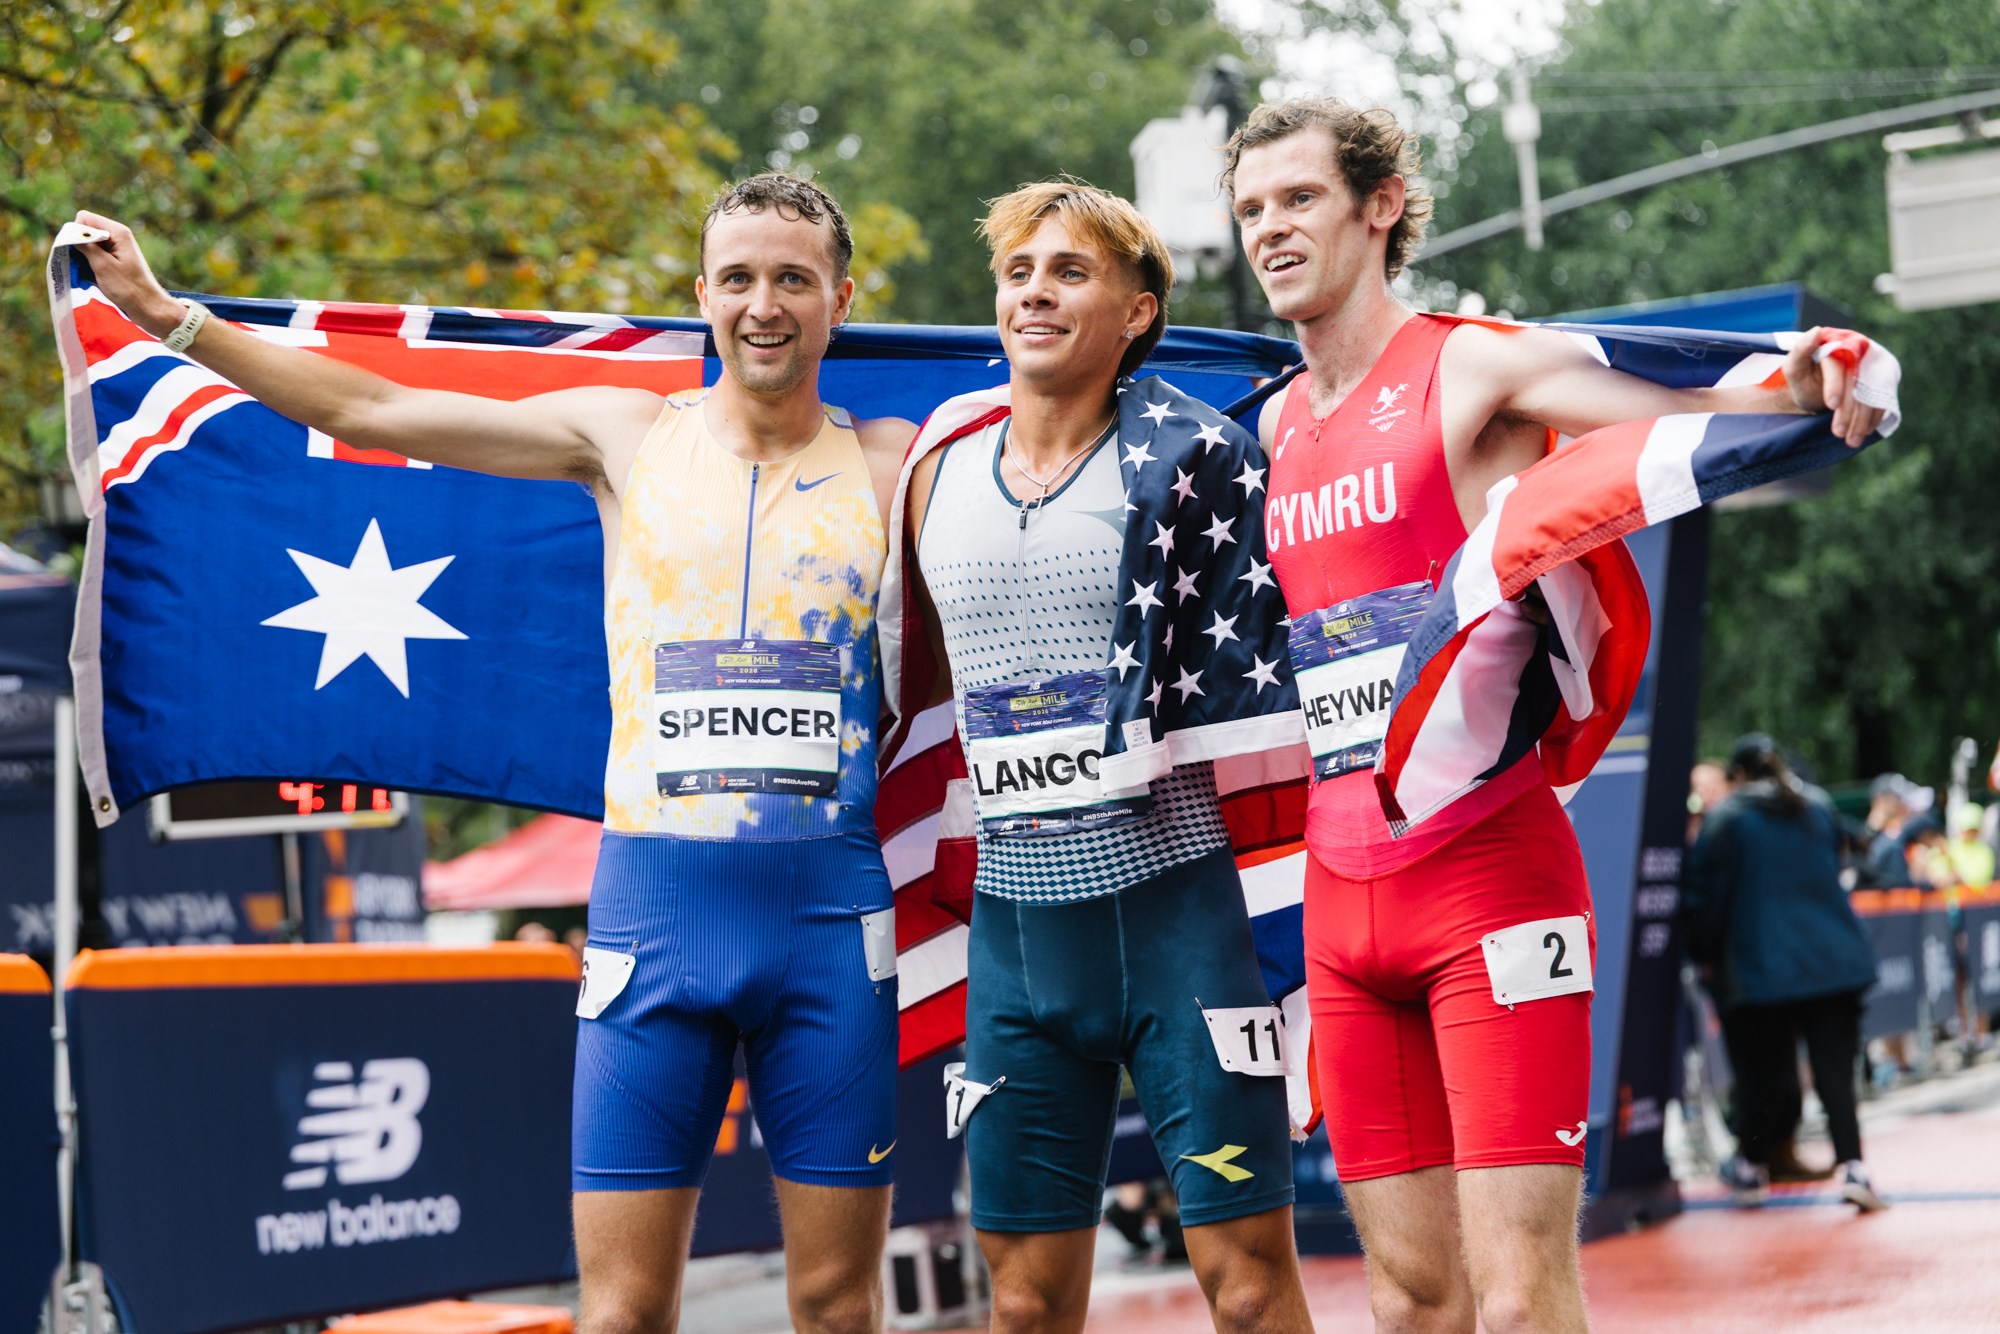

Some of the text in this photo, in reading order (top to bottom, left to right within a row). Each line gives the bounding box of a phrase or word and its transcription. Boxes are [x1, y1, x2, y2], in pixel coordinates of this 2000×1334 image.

[1266, 461, 1397, 553] CYMRU
[1349, 613, 1373, 628] MILE
[753, 656, 779, 664] MILE
[1042, 693, 1067, 705] MILE
[658, 707, 837, 739] SPENCER
[1082, 808, 1133, 821] #NB5thAveMile
[1543, 932, 1573, 979] 2
[1239, 1019, 1282, 1062] 11
[256, 1194, 461, 1256] new balance
